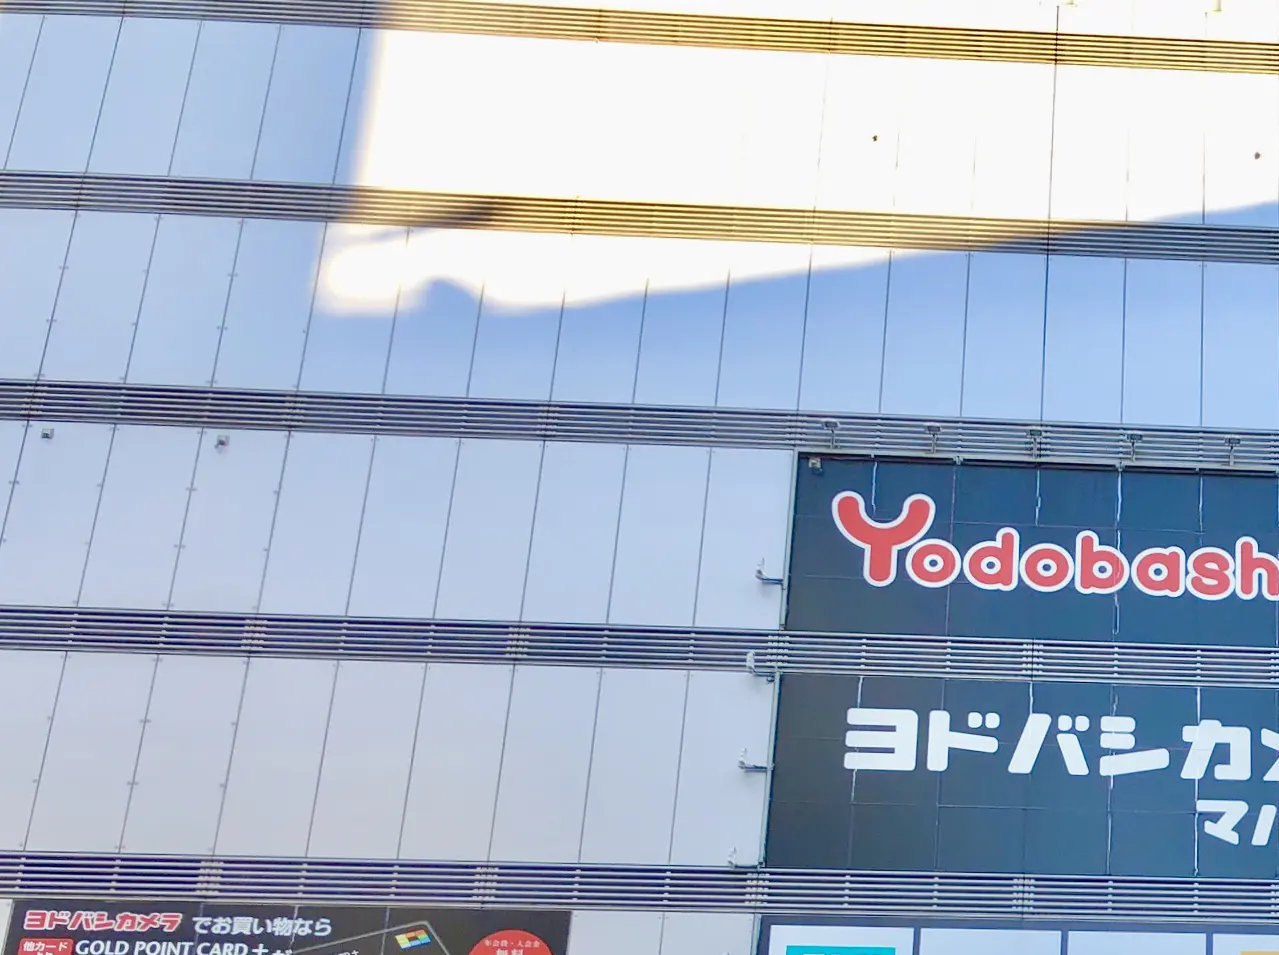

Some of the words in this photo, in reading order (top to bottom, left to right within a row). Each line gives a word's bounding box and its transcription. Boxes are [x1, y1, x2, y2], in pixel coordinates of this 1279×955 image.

[23, 909, 183, 932] ヨドバシカメラ
[191, 915, 333, 938] でお買い物なら
[23, 940, 68, 953] 他カード
